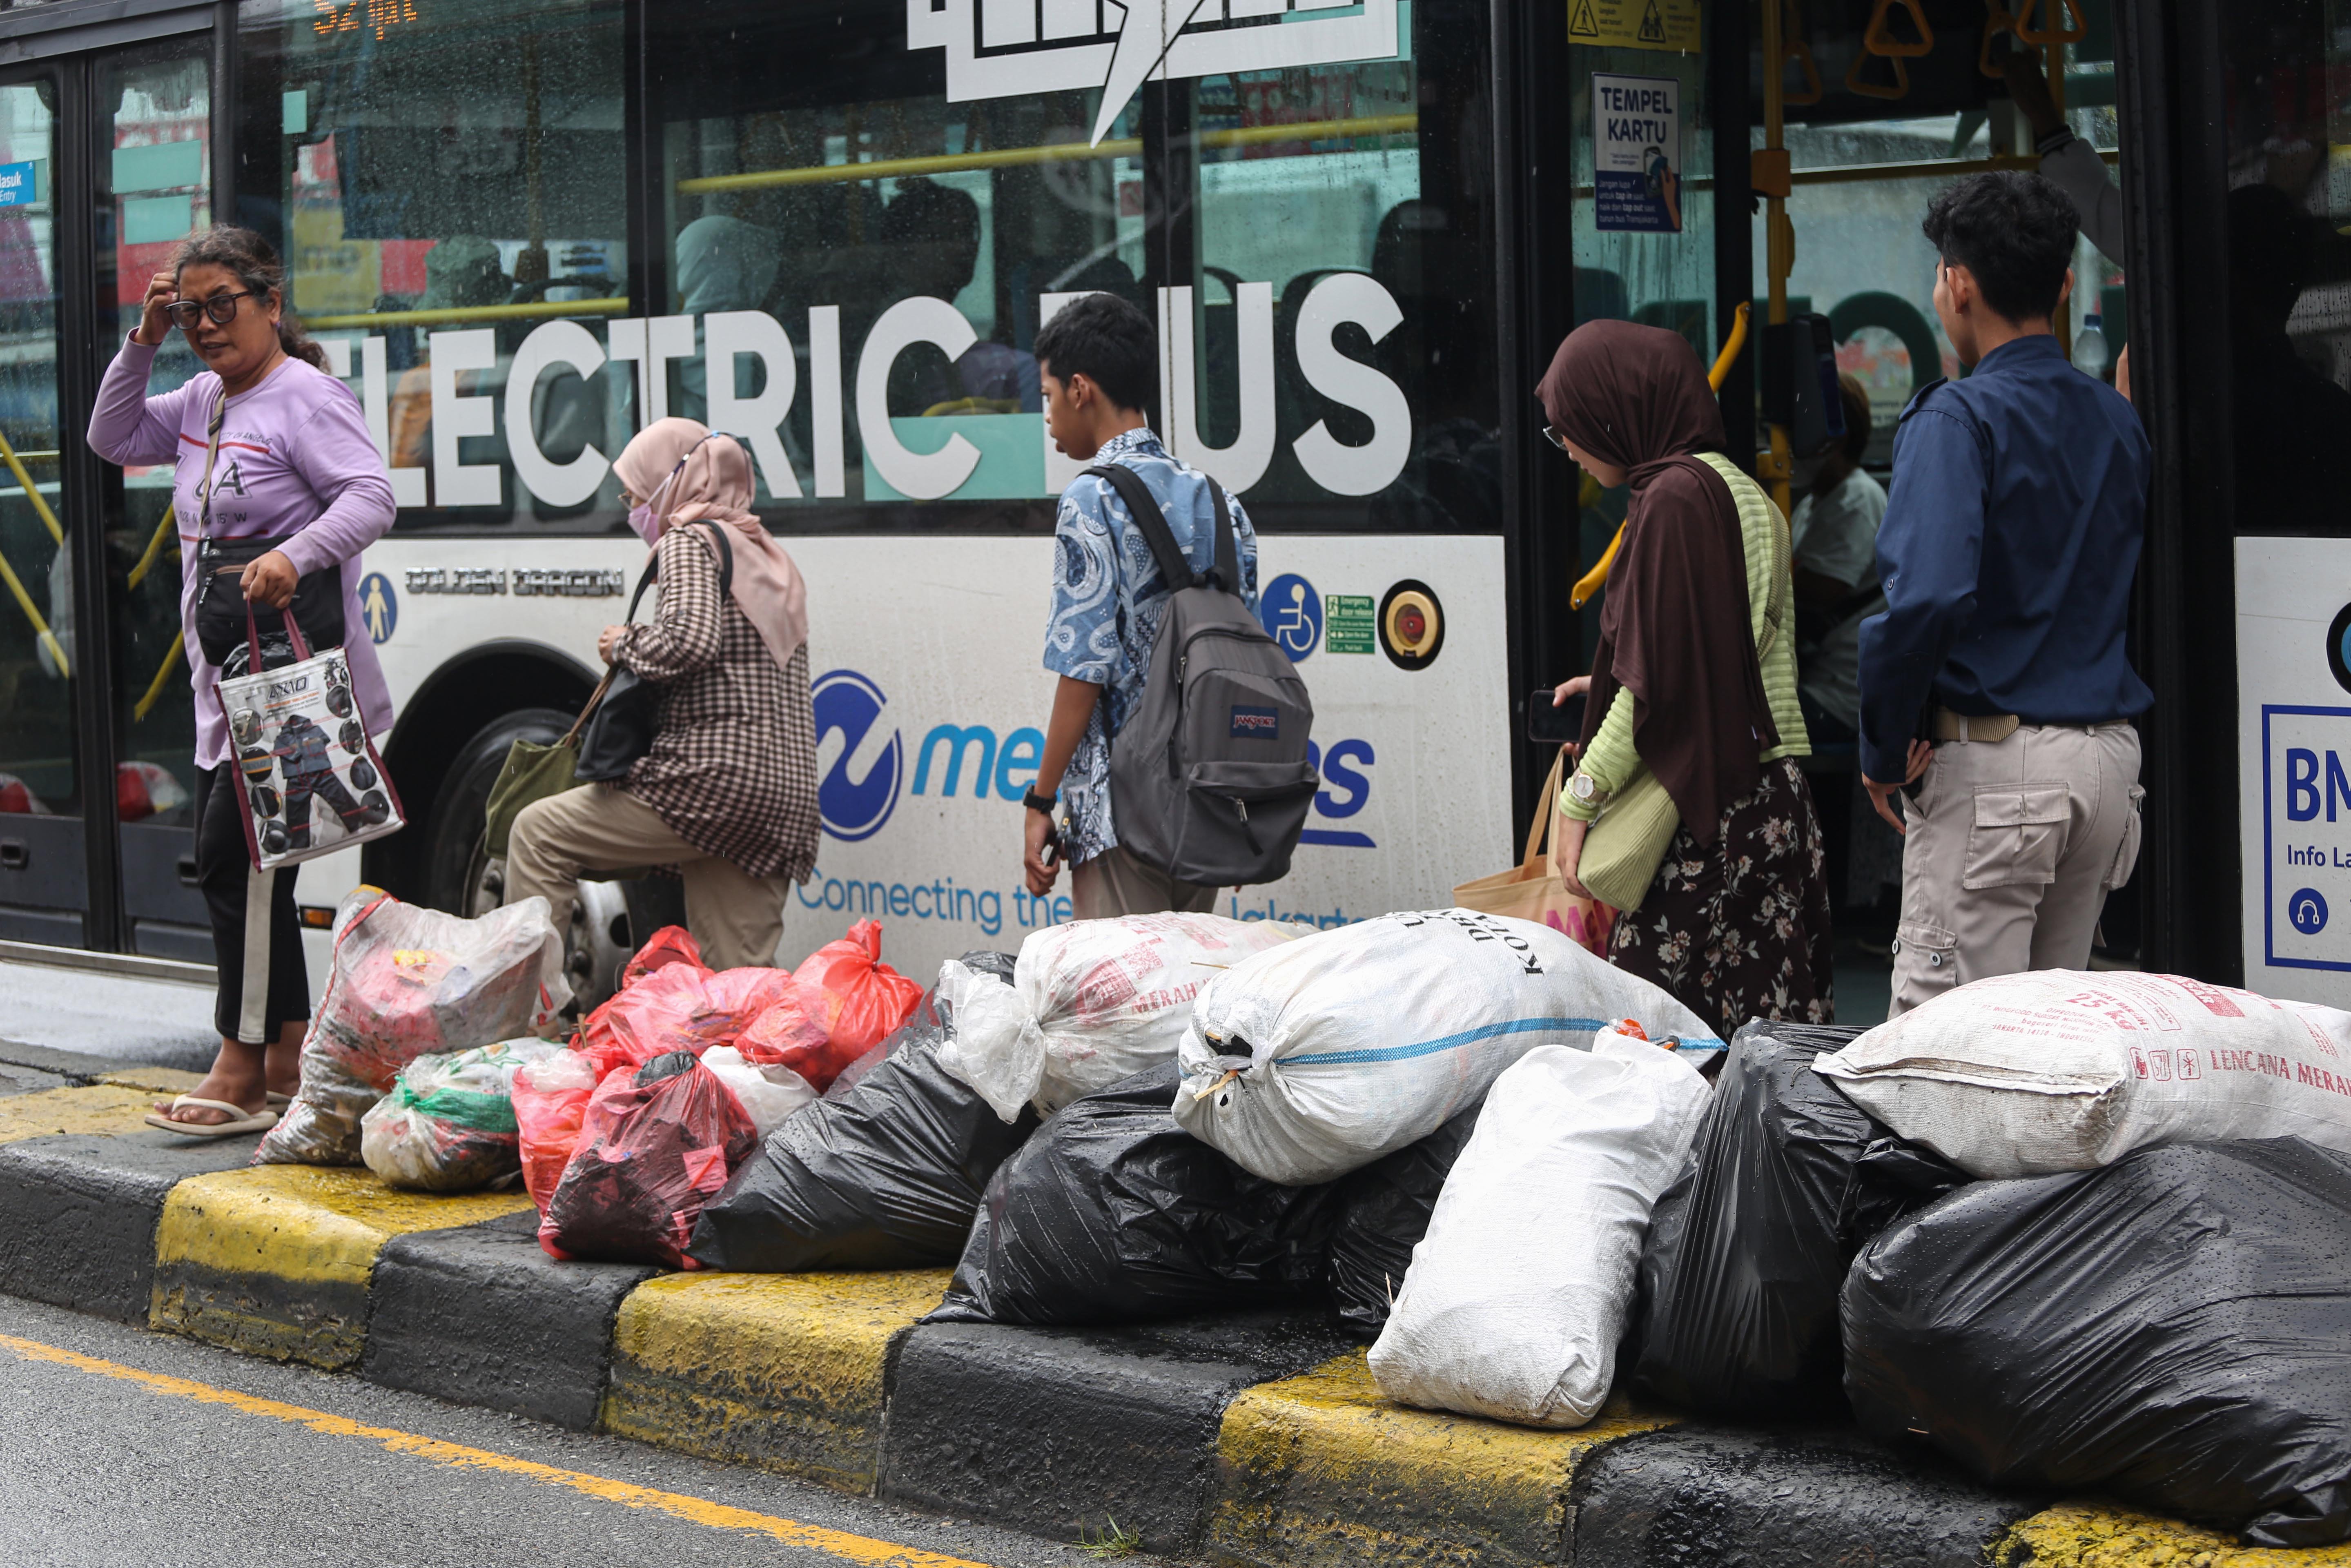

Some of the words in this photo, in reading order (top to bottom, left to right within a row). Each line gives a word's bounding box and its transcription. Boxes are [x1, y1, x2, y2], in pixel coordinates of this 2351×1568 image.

[1600, 87, 1673, 114] TEMPEL
[1607, 118, 1667, 144] KARTU
[234, 512, 247, 522] W
[405, 567, 506, 594] GOLDEN
[513, 567, 624, 596] DRAGON
[1233, 715, 1275, 730] JANSPORT
[2288, 844, 2326, 867] Info
[796, 867, 1001, 935] Connecting
[1013, 884, 1073, 927] the
[1130, 982, 1197, 1015] MERAH
[2065, 993, 2109, 1008] 25
[1992, 1024, 2023, 1034] JAKARTA
[2210, 1049, 2291, 1080] LENCANA
